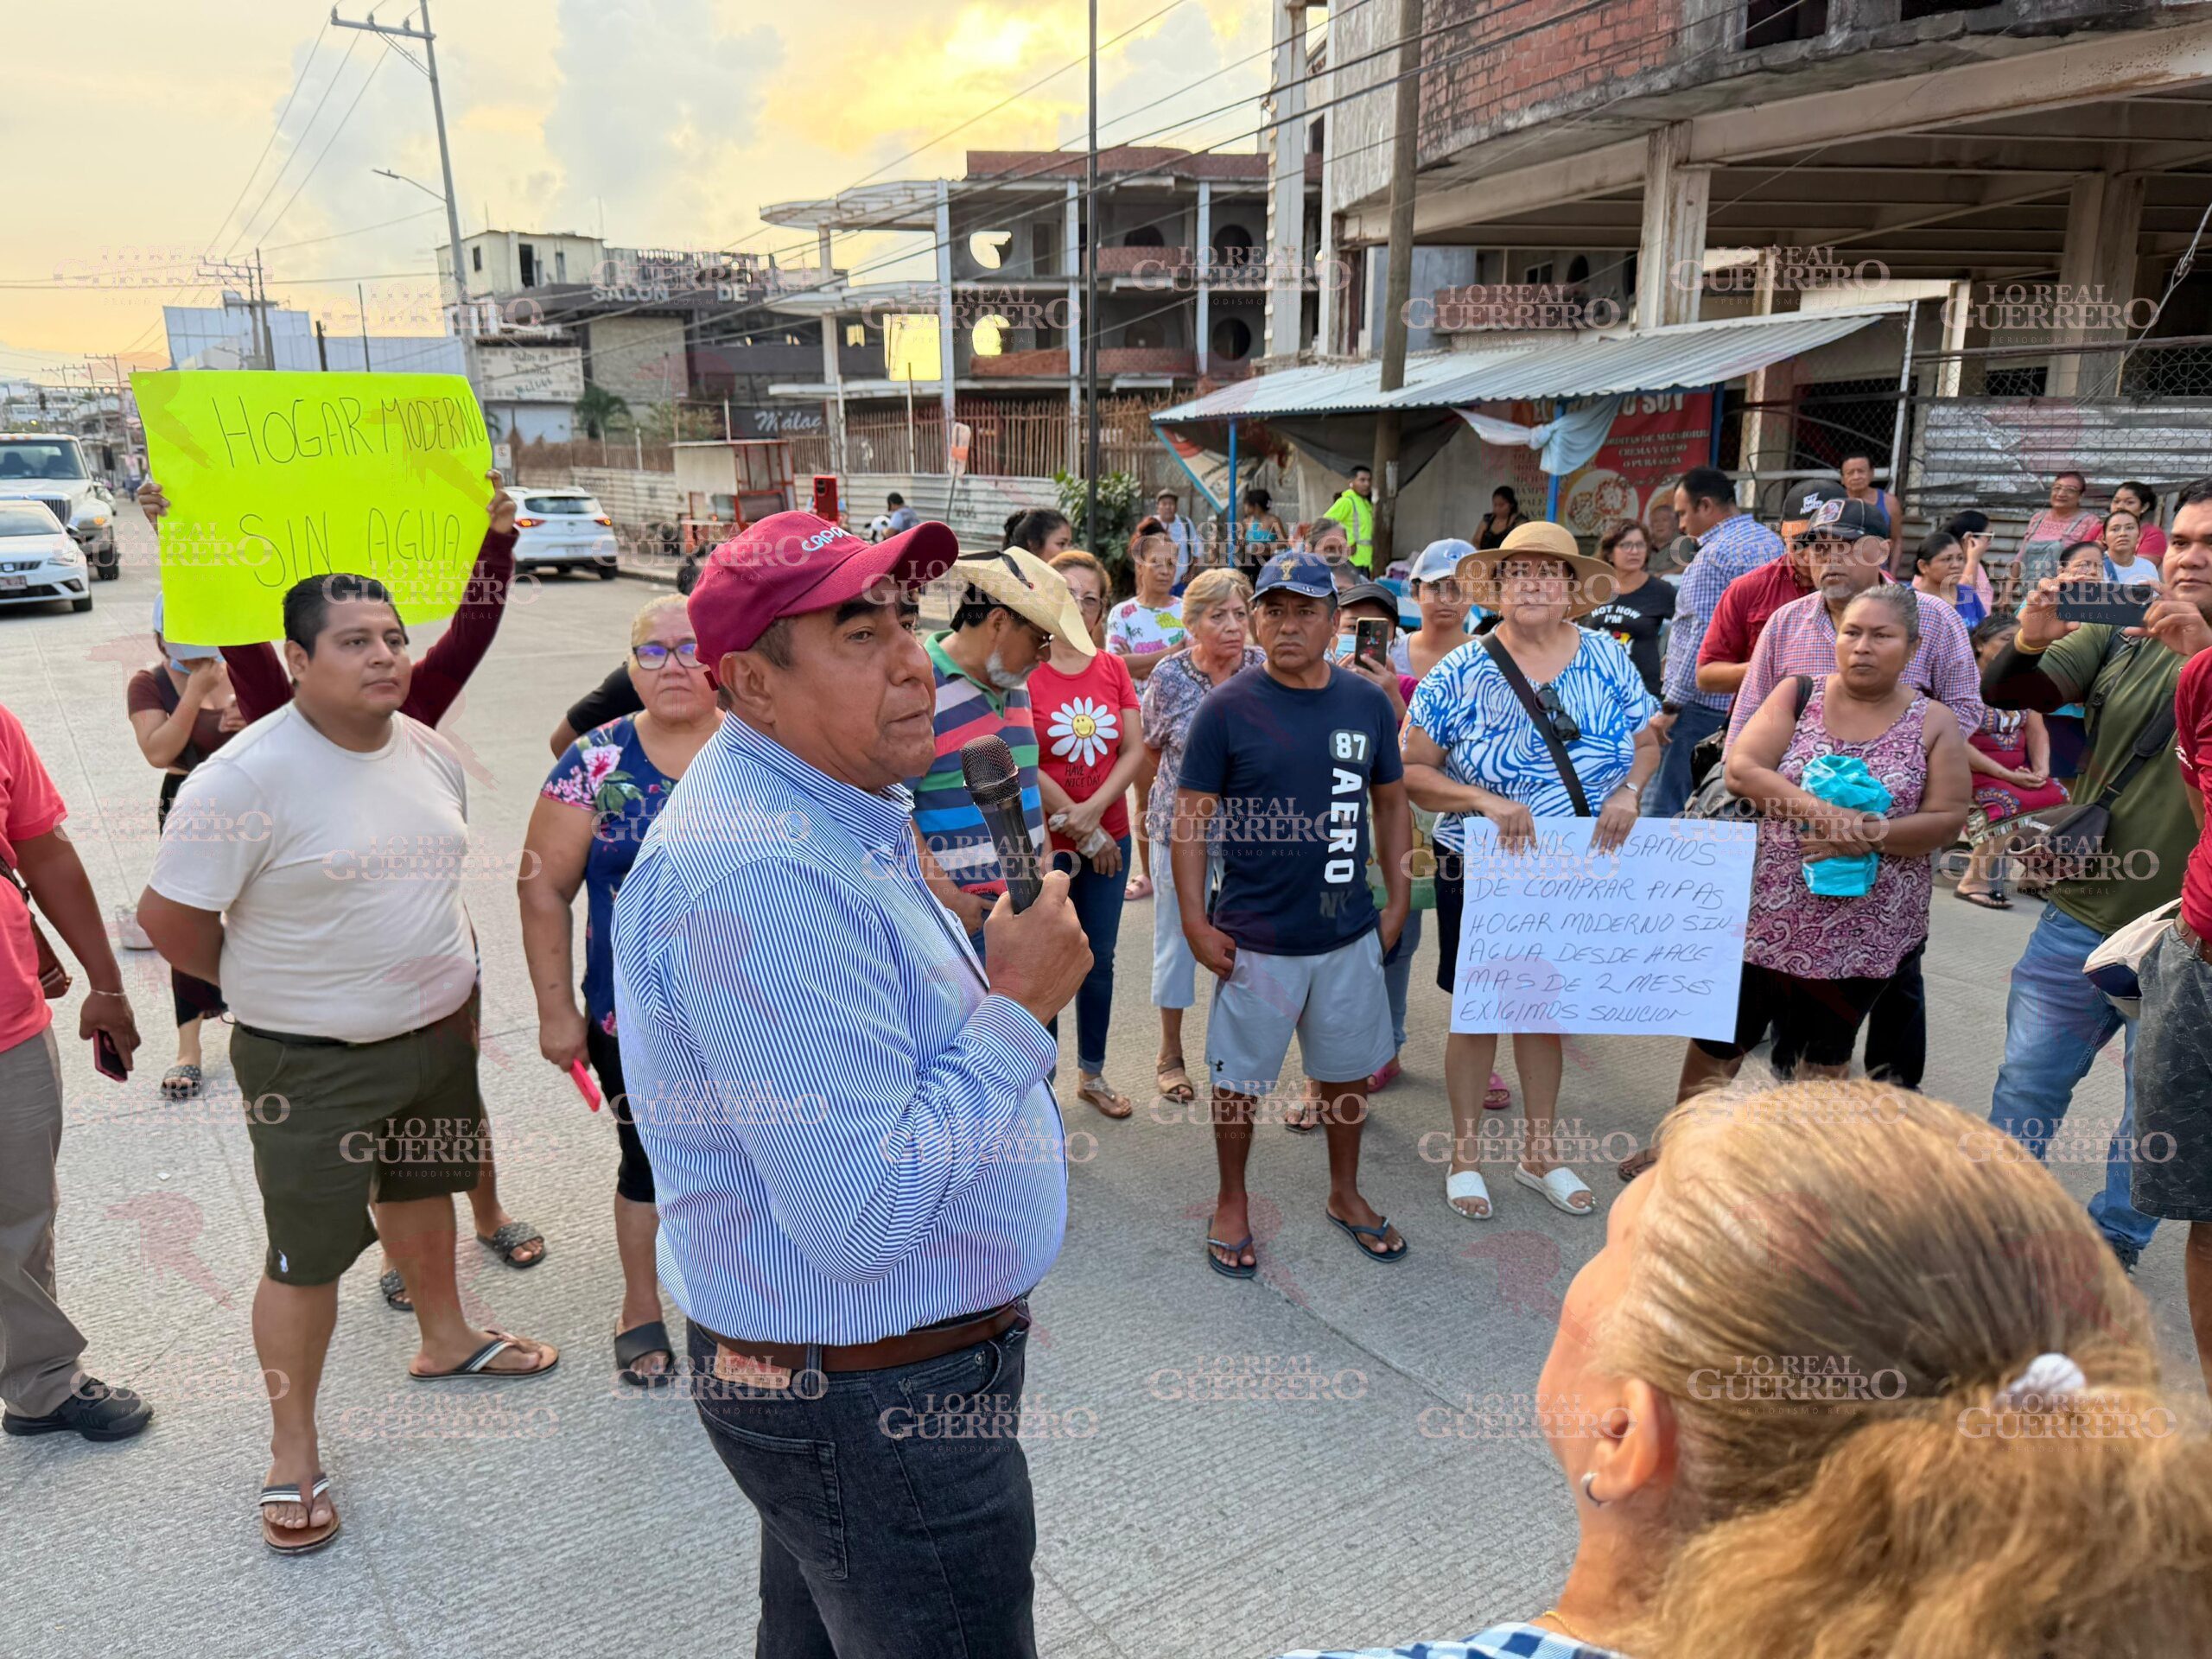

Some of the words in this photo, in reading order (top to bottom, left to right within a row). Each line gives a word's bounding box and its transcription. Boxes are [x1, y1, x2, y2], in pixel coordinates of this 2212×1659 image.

[212, 395, 374, 468] HOGAR
[380, 394, 486, 454] MODERNO
[239, 511, 333, 588] SIN
[368, 507, 461, 571] AGUA
[1591, 604, 1613, 618] NOT
[1615, 605, 1642, 620] NOW
[1604, 614, 1624, 624] I'M
[1335, 732, 1367, 760] 87
[1065, 765, 1084, 776] HAVE
[1065, 776, 1085, 788] NICE
[1087, 774, 1101, 787] DAY
[1324, 767, 1363, 884] AERO
[1470, 877, 1510, 903] DE
[1523, 875, 1638, 902] COMPRAR
[1648, 880, 1726, 909] PIPAS
[1469, 912, 1554, 937] HOGAR
[1560, 912, 1675, 935] MODERNO
[1682, 915, 1732, 932] SIN
[1469, 938, 1544, 963] AGUA
[1554, 942, 1639, 964] DESDE
[1644, 943, 1713, 963] HACE
[1465, 968, 1535, 995] MAS
[1547, 973, 1581, 994] DE
[1595, 973, 1622, 995] 2
[1627, 972, 1715, 995] MESES
[1459, 1000, 1580, 1023] EXIGIMOS
[1586, 1005, 1694, 1023] SOLUCION
